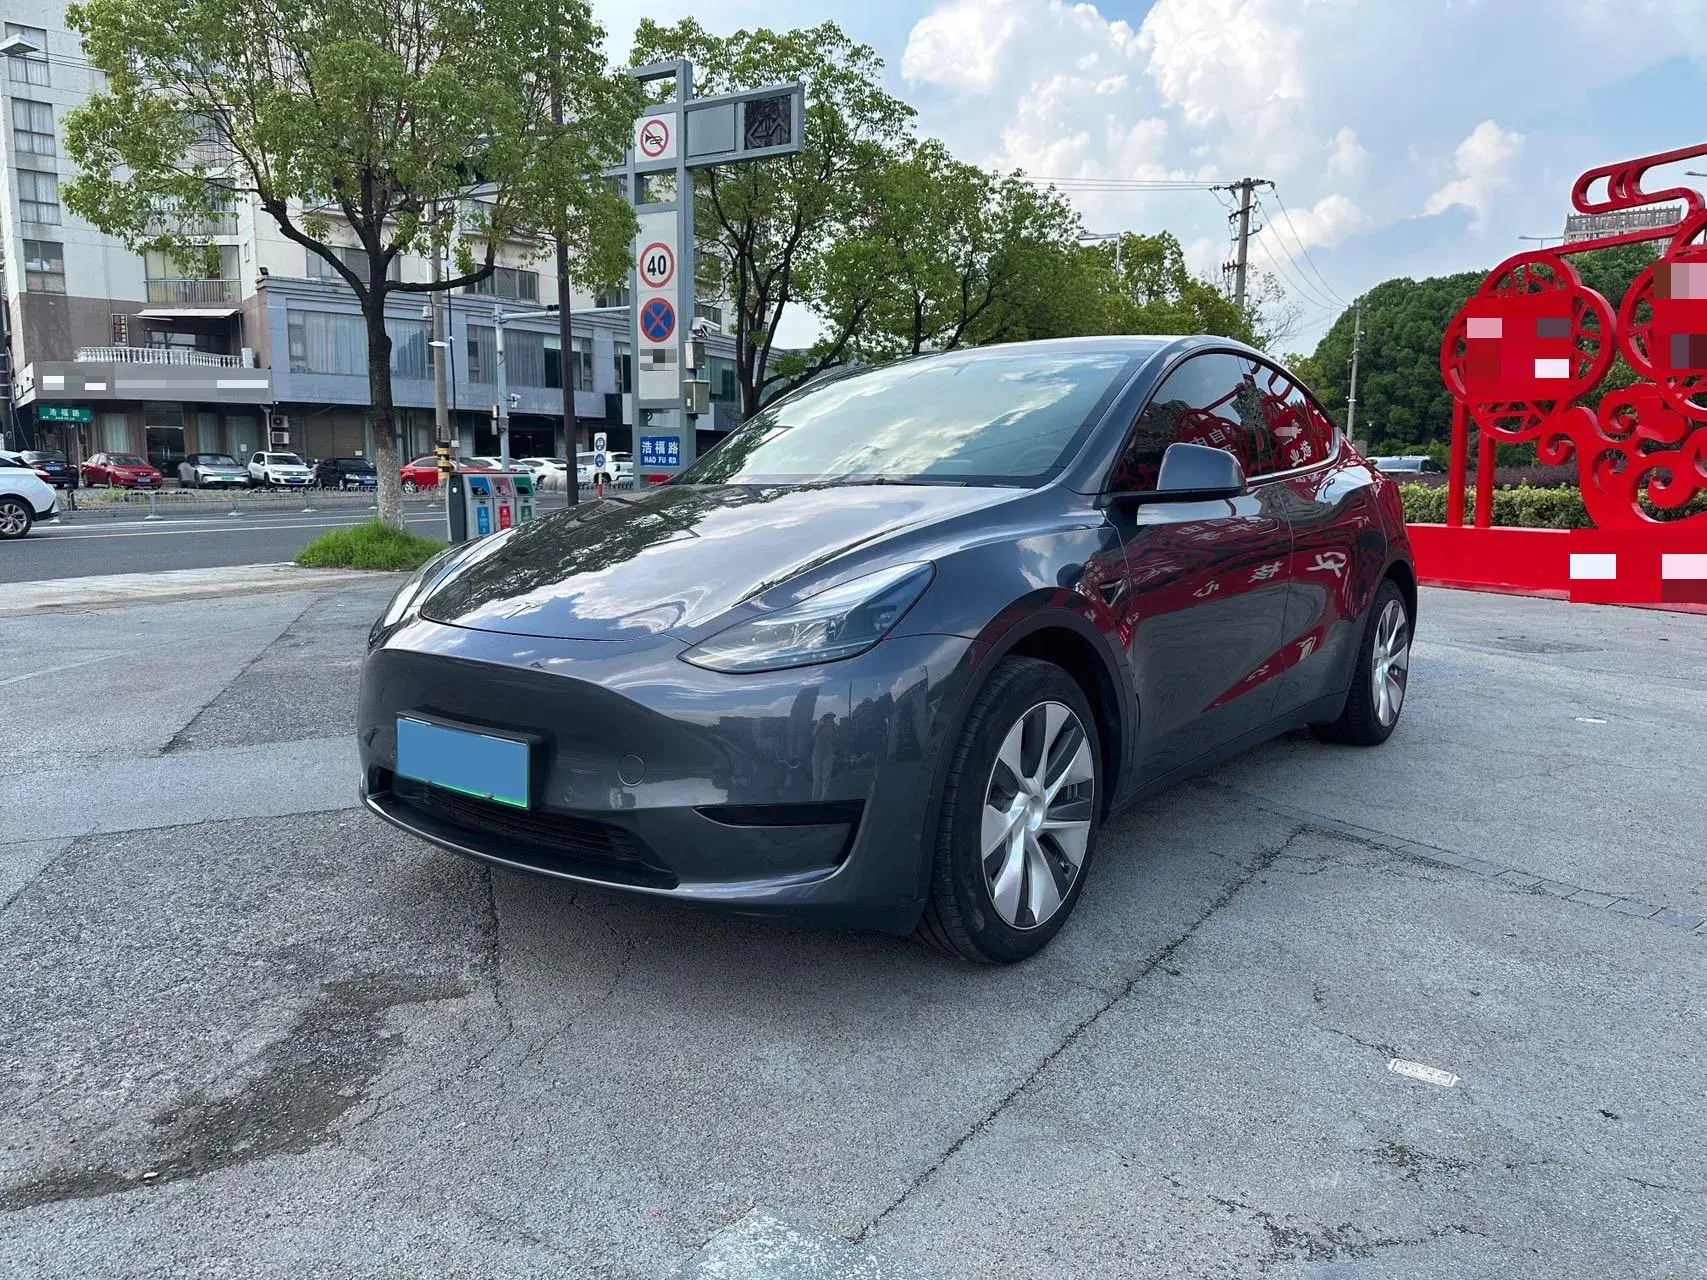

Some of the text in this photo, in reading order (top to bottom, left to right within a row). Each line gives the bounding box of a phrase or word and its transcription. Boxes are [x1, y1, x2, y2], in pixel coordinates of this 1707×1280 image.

[647, 255, 667, 276] 40
[642, 441, 678, 454] 浩福路
